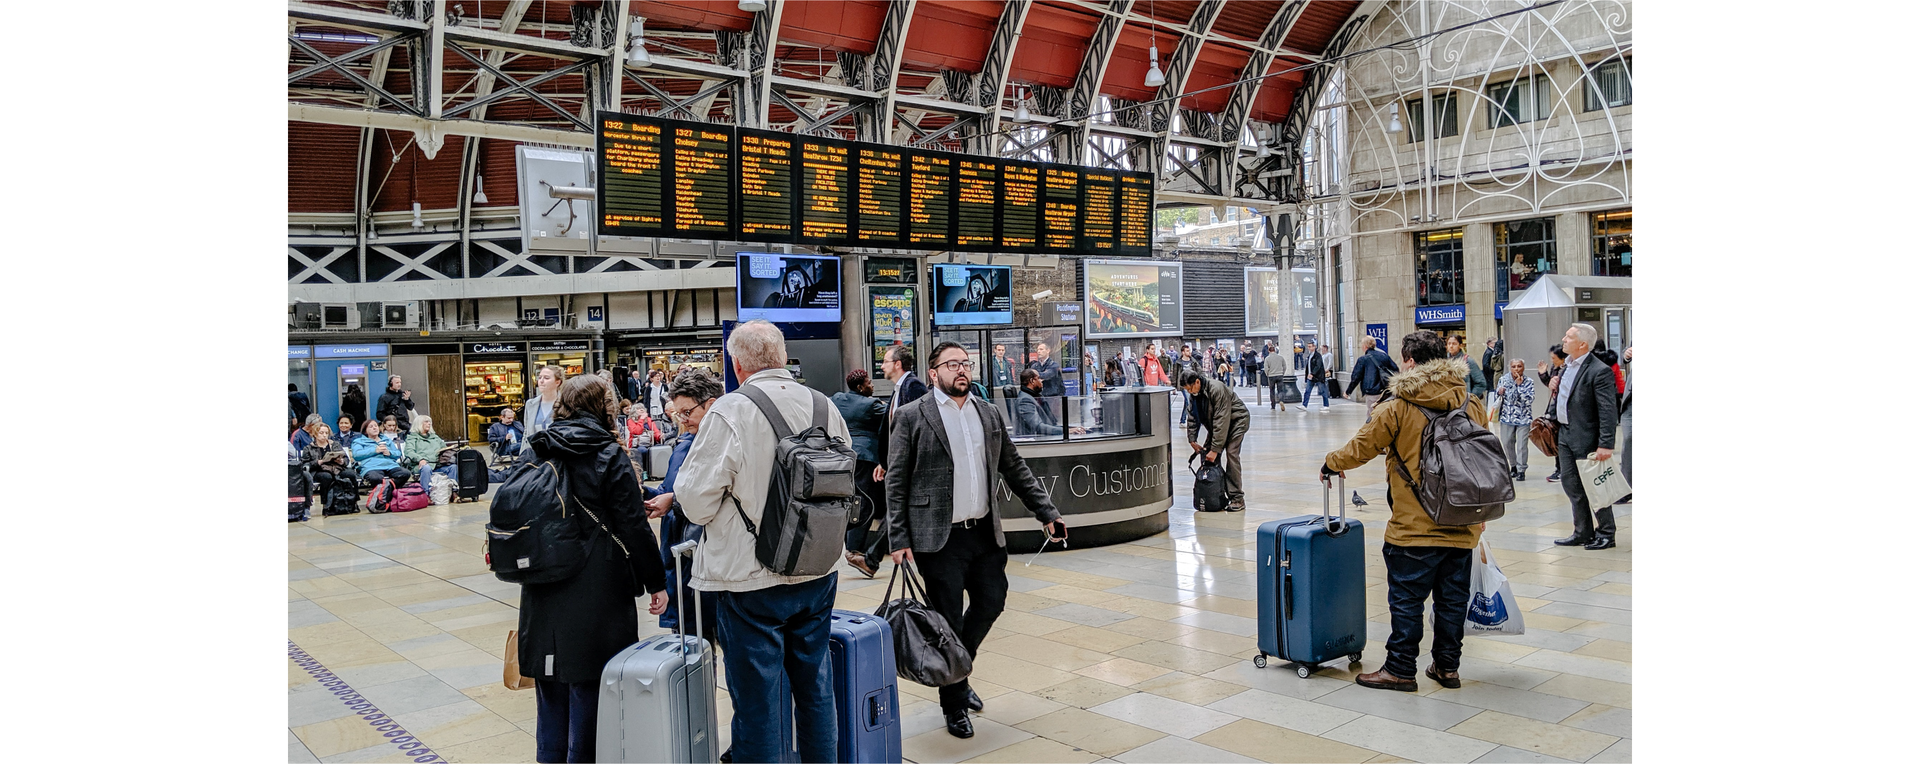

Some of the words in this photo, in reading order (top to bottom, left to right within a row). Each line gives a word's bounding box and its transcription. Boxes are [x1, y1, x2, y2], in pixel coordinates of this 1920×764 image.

[604, 120, 623, 130] 13:22
[632, 124, 660, 134] Boarding
[676, 129, 693, 137] 13:27
[701, 131, 728, 142] Boarding
[675, 138, 699, 147] Cholsey
[743, 136, 759, 144] 13:30
[764, 138, 790, 148] Preparing
[742, 144, 762, 154] Bristol
[803, 152, 828, 160] Heathrow
[860, 158, 887, 167] Cheltenham
[874, 299, 910, 309] escape
[1056, 304, 1080, 313] Paddington
[526, 312, 537, 320] 12
[590, 309, 600, 318] 14
[1419, 309, 1463, 320] WHSmith
[875, 318, 892, 326] YOUR
[1368, 328, 1386, 337] WH
[1472, 604, 1496, 618] Together
